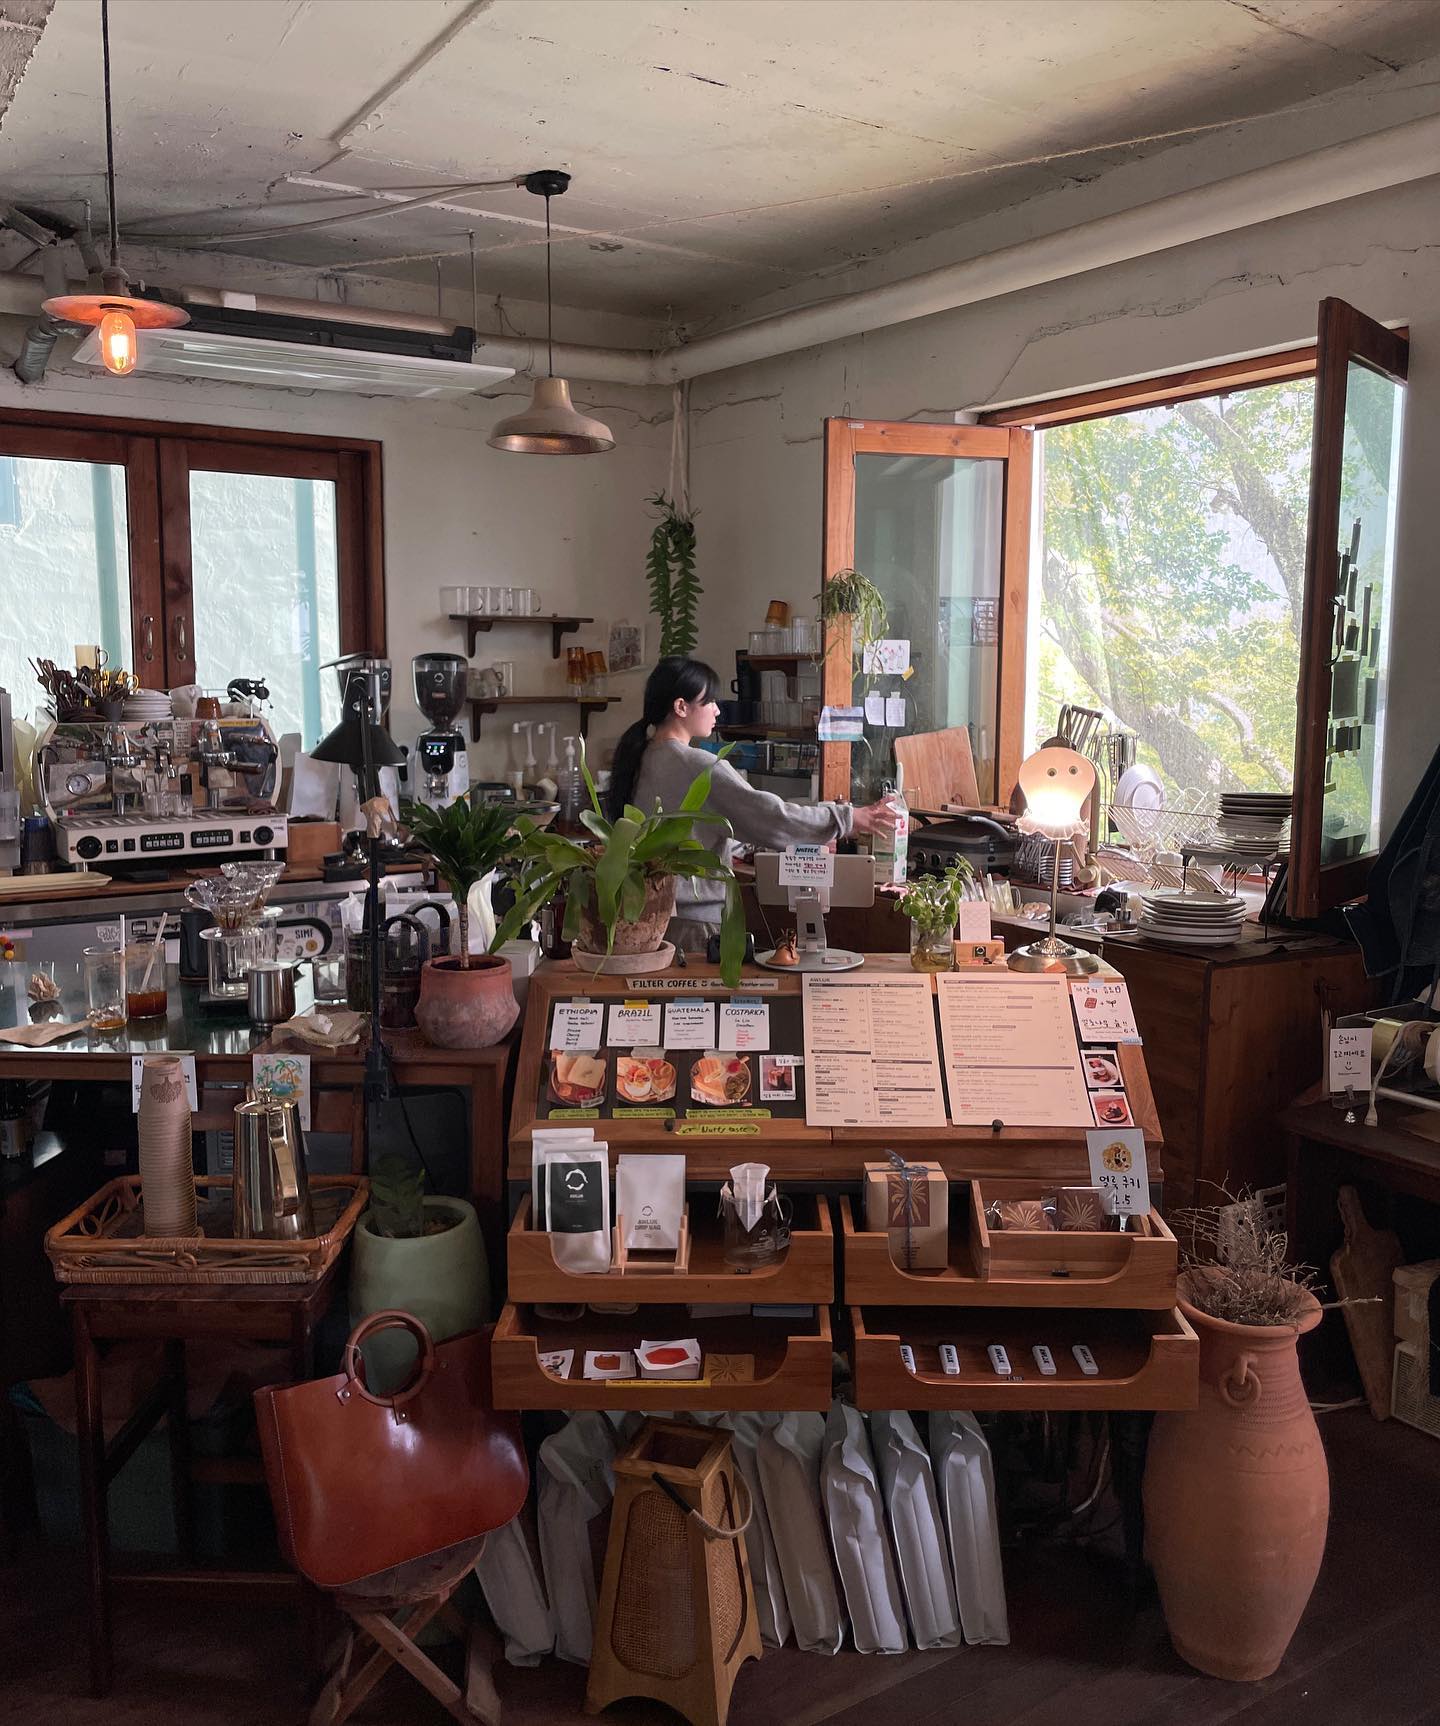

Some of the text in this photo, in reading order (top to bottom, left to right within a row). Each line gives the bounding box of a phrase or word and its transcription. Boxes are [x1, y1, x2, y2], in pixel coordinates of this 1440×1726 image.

[632, 979, 698, 988] FILTER COFFEE
[617, 1009, 653, 1018] BRAZIL
[701, 1125, 726, 1134] Nutty
[1122, 1175, 1141, 1190] 쿠키
